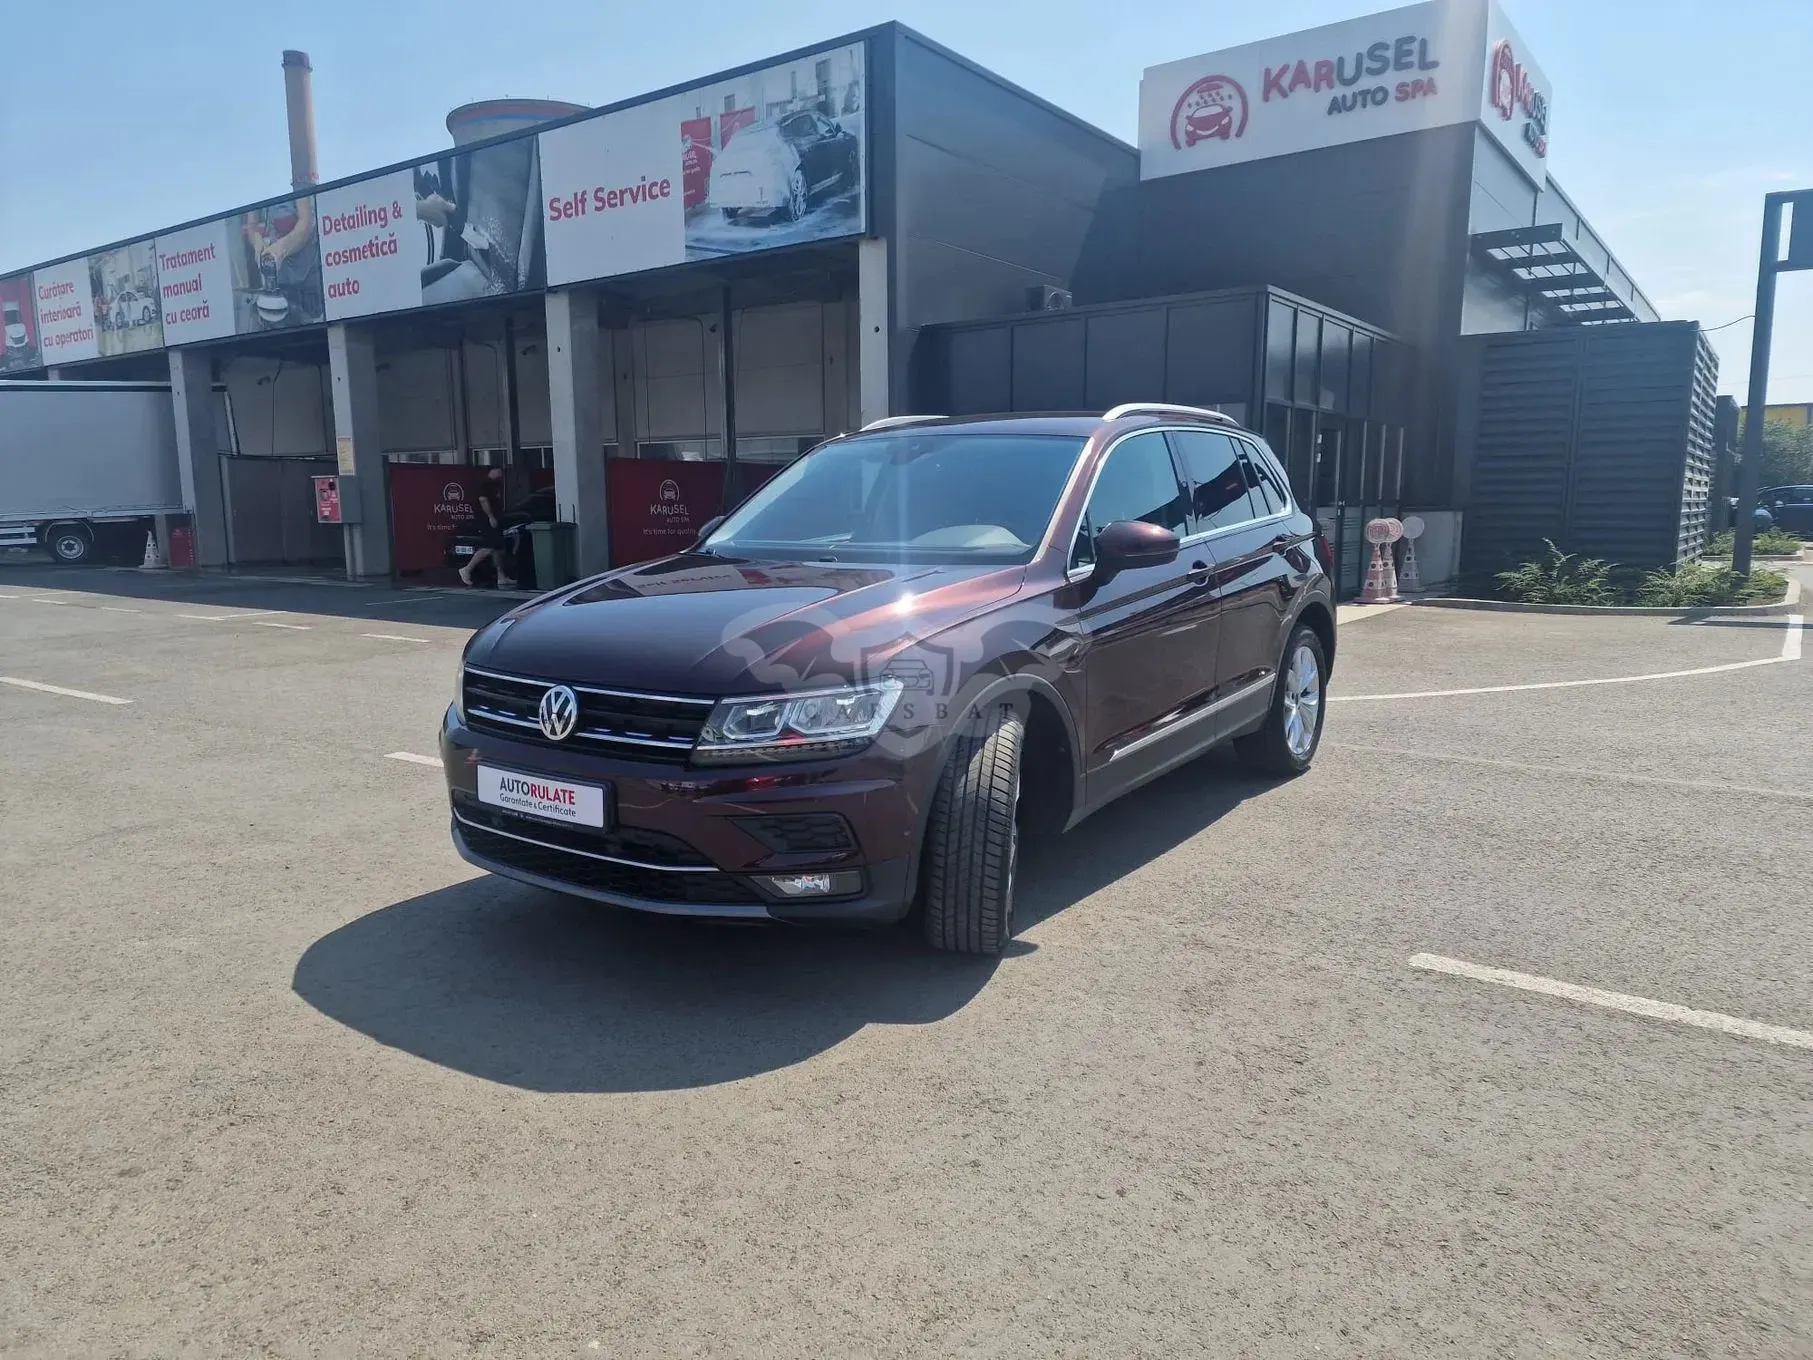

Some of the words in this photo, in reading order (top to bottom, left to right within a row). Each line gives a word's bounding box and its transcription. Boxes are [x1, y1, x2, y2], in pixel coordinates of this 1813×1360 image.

[1262, 35, 1440, 103] KARUSEL
[1327, 85, 1389, 116] AUTO
[1394, 76, 1439, 104] SPA
[548, 192, 588, 222] Self
[593, 175, 672, 213] Service
[321, 207, 388, 237] Detailing
[392, 200, 403, 220] &
[159, 242, 216, 272] Tratament
[324, 232, 398, 268] cosmetică
[162, 273, 203, 299] manual
[327, 276, 360, 300] auto
[165, 312, 178, 326] cu
[178, 299, 210, 323] ceară
[43, 335, 55, 347] cu
[55, 325, 94, 349] operatori
[433, 503, 474, 514] KARUSEL
[650, 503, 691, 516] KARUSEL
[499, 776, 576, 805] AUTORULATE
[499, 792, 533, 809] Garantate
[537, 801, 577, 817] Certificate
